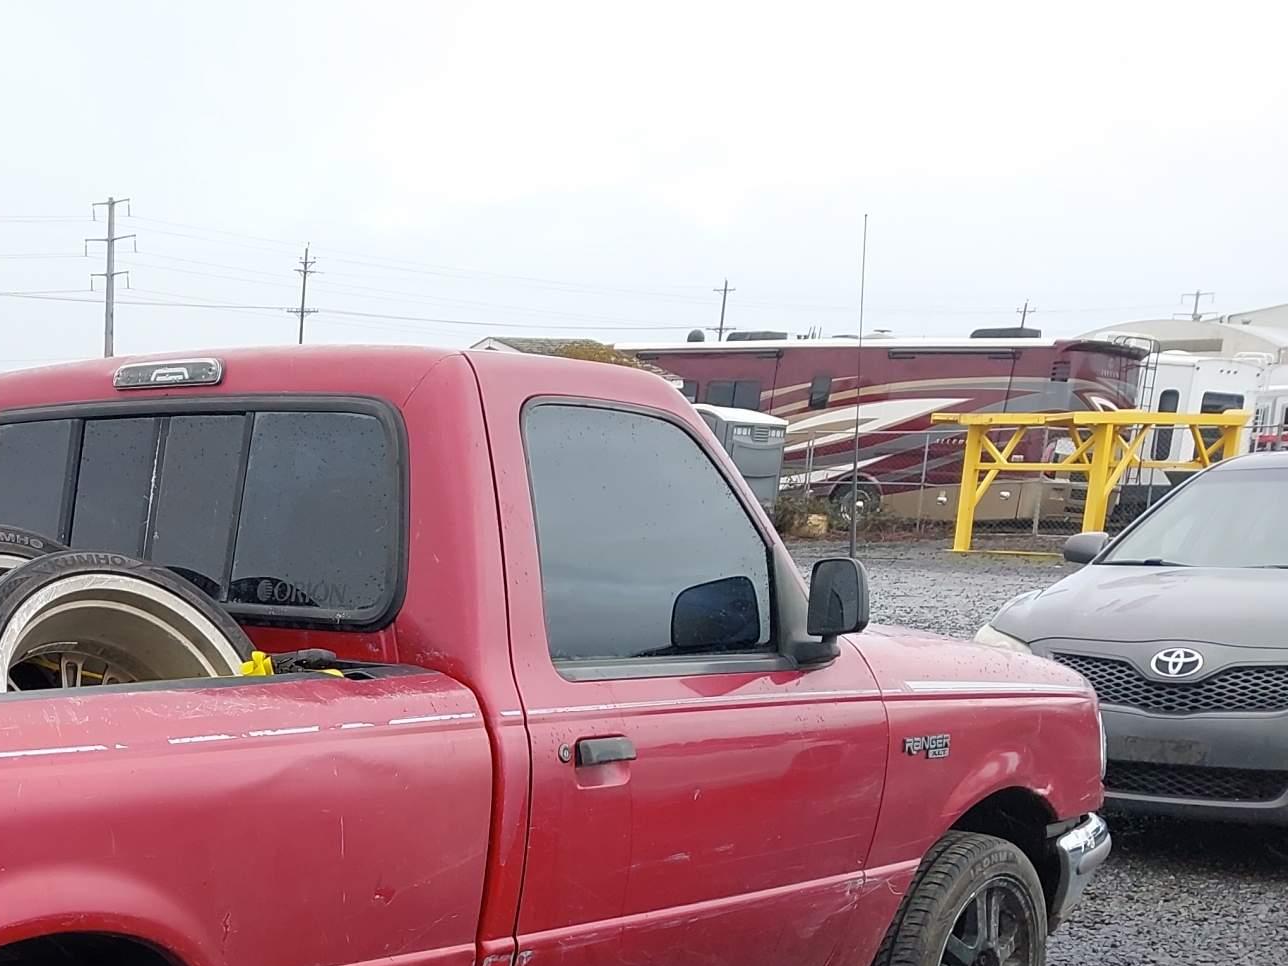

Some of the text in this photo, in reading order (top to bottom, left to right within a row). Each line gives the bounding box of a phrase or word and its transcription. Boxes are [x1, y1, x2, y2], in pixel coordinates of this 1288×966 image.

[54, 552, 126, 568] KUMHO
[273, 580, 348, 604] ORION
[903, 733, 951, 755] RANGER
